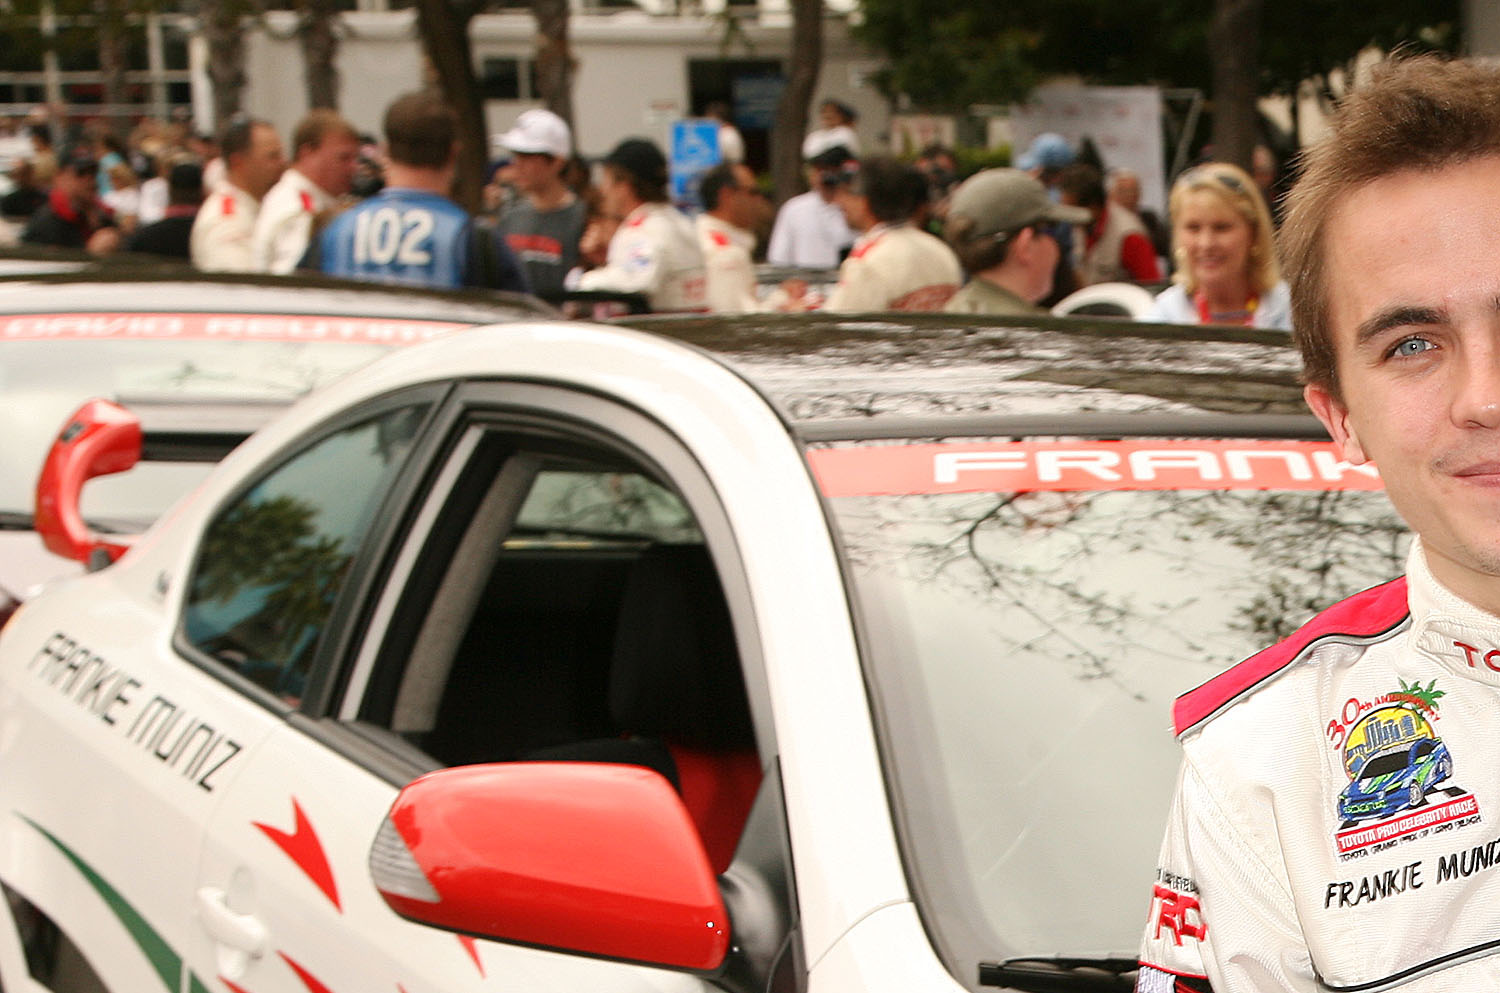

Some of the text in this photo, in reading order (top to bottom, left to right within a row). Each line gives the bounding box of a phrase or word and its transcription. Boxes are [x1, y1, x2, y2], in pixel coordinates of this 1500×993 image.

[353, 207, 434, 266] 102
[27, 633, 243, 792] FRANKIE MUNIZ
[1338, 827, 1376, 850] TOYOTA
[1324, 861, 1424, 909] FRANKIE
